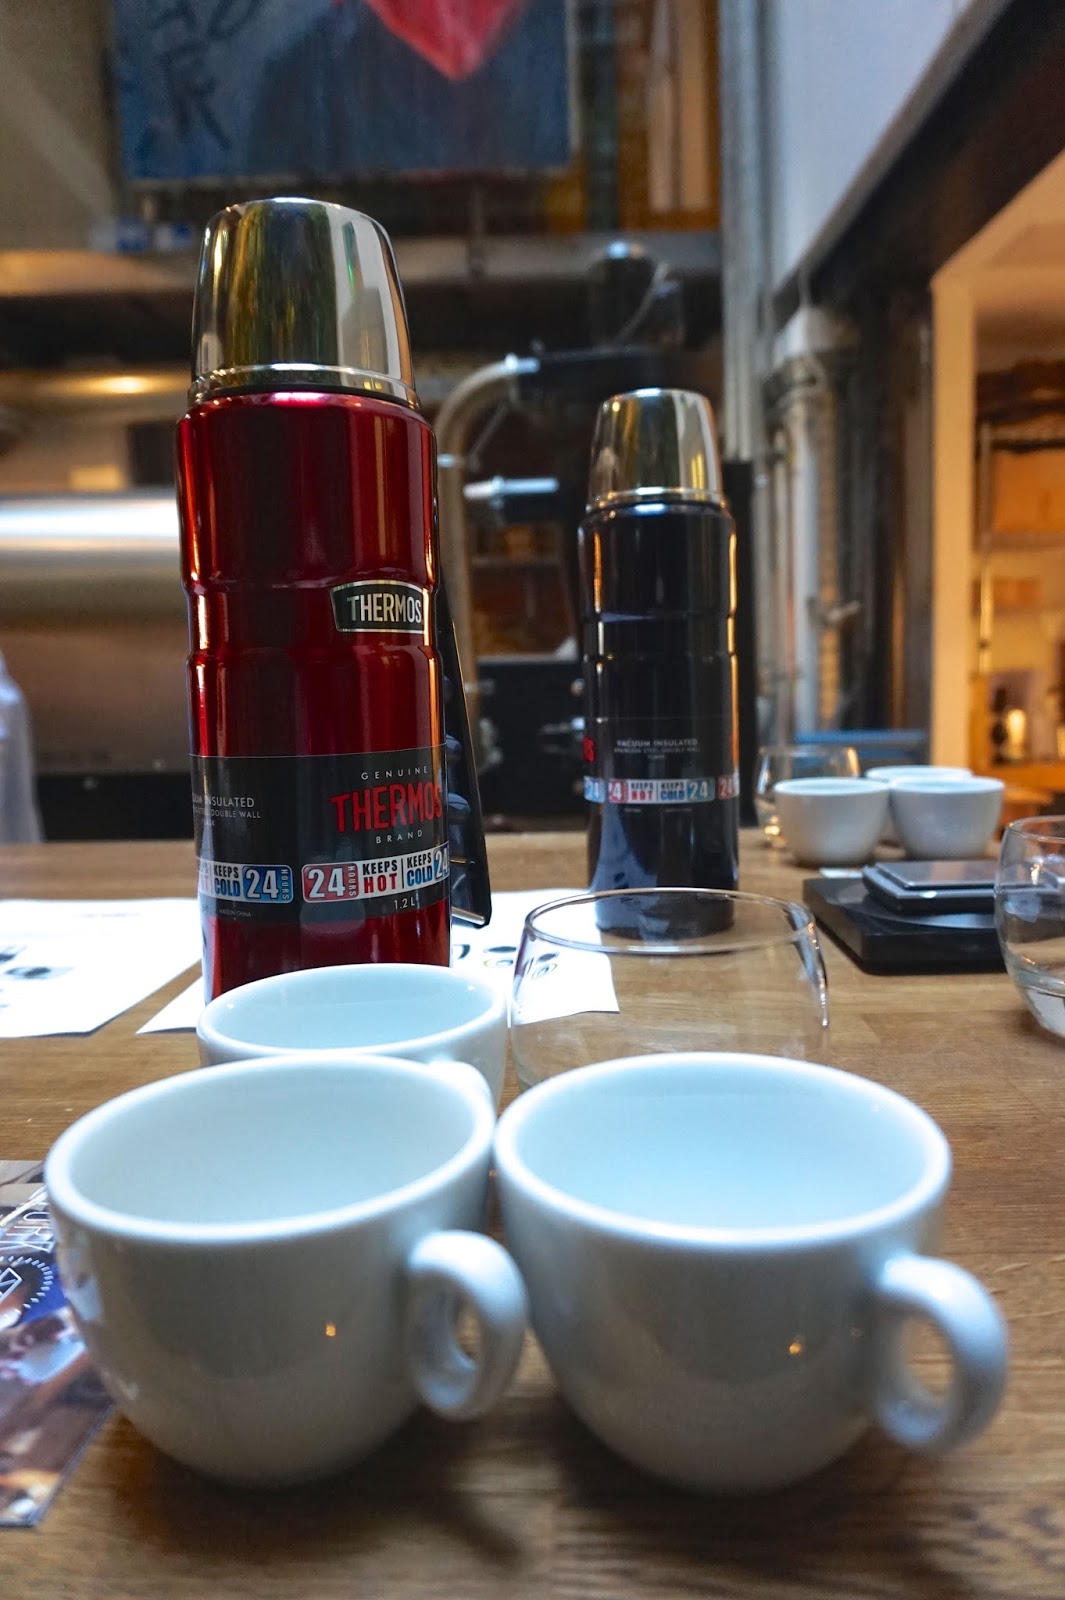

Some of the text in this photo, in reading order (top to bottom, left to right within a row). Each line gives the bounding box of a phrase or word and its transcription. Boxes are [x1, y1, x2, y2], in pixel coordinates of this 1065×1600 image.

[347, 593, 422, 624] THERMOS
[616, 738, 697, 747] VACUUM INSULATED
[361, 765, 428, 780] GENUINE
[661, 782, 684, 790] KEEPS
[690, 781, 708, 800] 24
[631, 790, 653, 801] HOT
[660, 790, 685, 801] COLD
[211, 809, 237, 818] DOUBLE
[238, 811, 261, 819] WALL
[330, 782, 443, 832] THERMOS
[375, 830, 423, 844] BRAND
[362, 859, 398, 876] KEEPS
[406, 851, 432, 869] KEEPS
[435, 847, 448, 878] 24
[213, 864, 240, 879] KEEPS
[406, 866, 433, 887] COLD
[214, 878, 241, 897] COLD
[245, 868, 279, 899] 24
[280, 868, 290, 900] HOURS
[308, 867, 345, 899] 24
[347, 865, 357, 897] HOURS
[363, 873, 398, 895] HOT
[236, 910, 252, 918] CHINA
